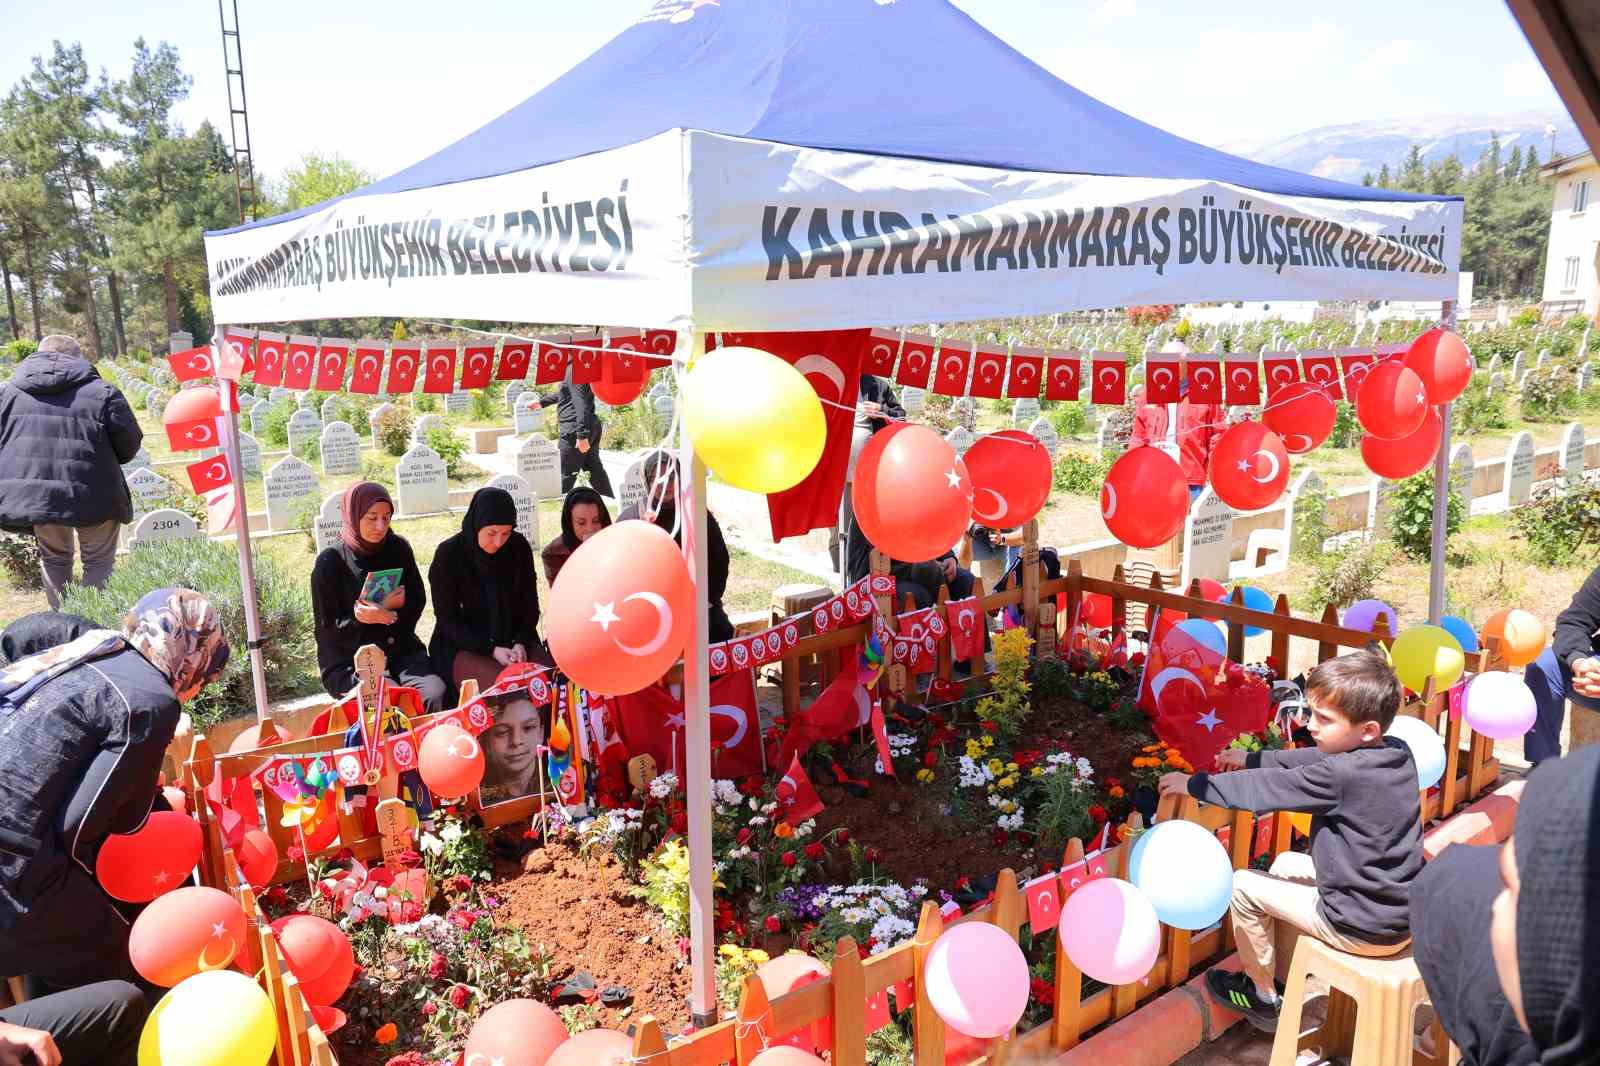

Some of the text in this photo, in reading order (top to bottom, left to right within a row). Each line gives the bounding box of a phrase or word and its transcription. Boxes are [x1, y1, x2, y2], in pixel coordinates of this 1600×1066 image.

[325, 211, 446, 288] BÜYÜKŞEHİR
[447, 178, 634, 275] BELEDİYESİ
[762, 195, 1448, 281] KAHRAMANMARAŞ BÜYÜKŞEHİR BELEDİYESİ
[152, 520, 180, 530] 2304
